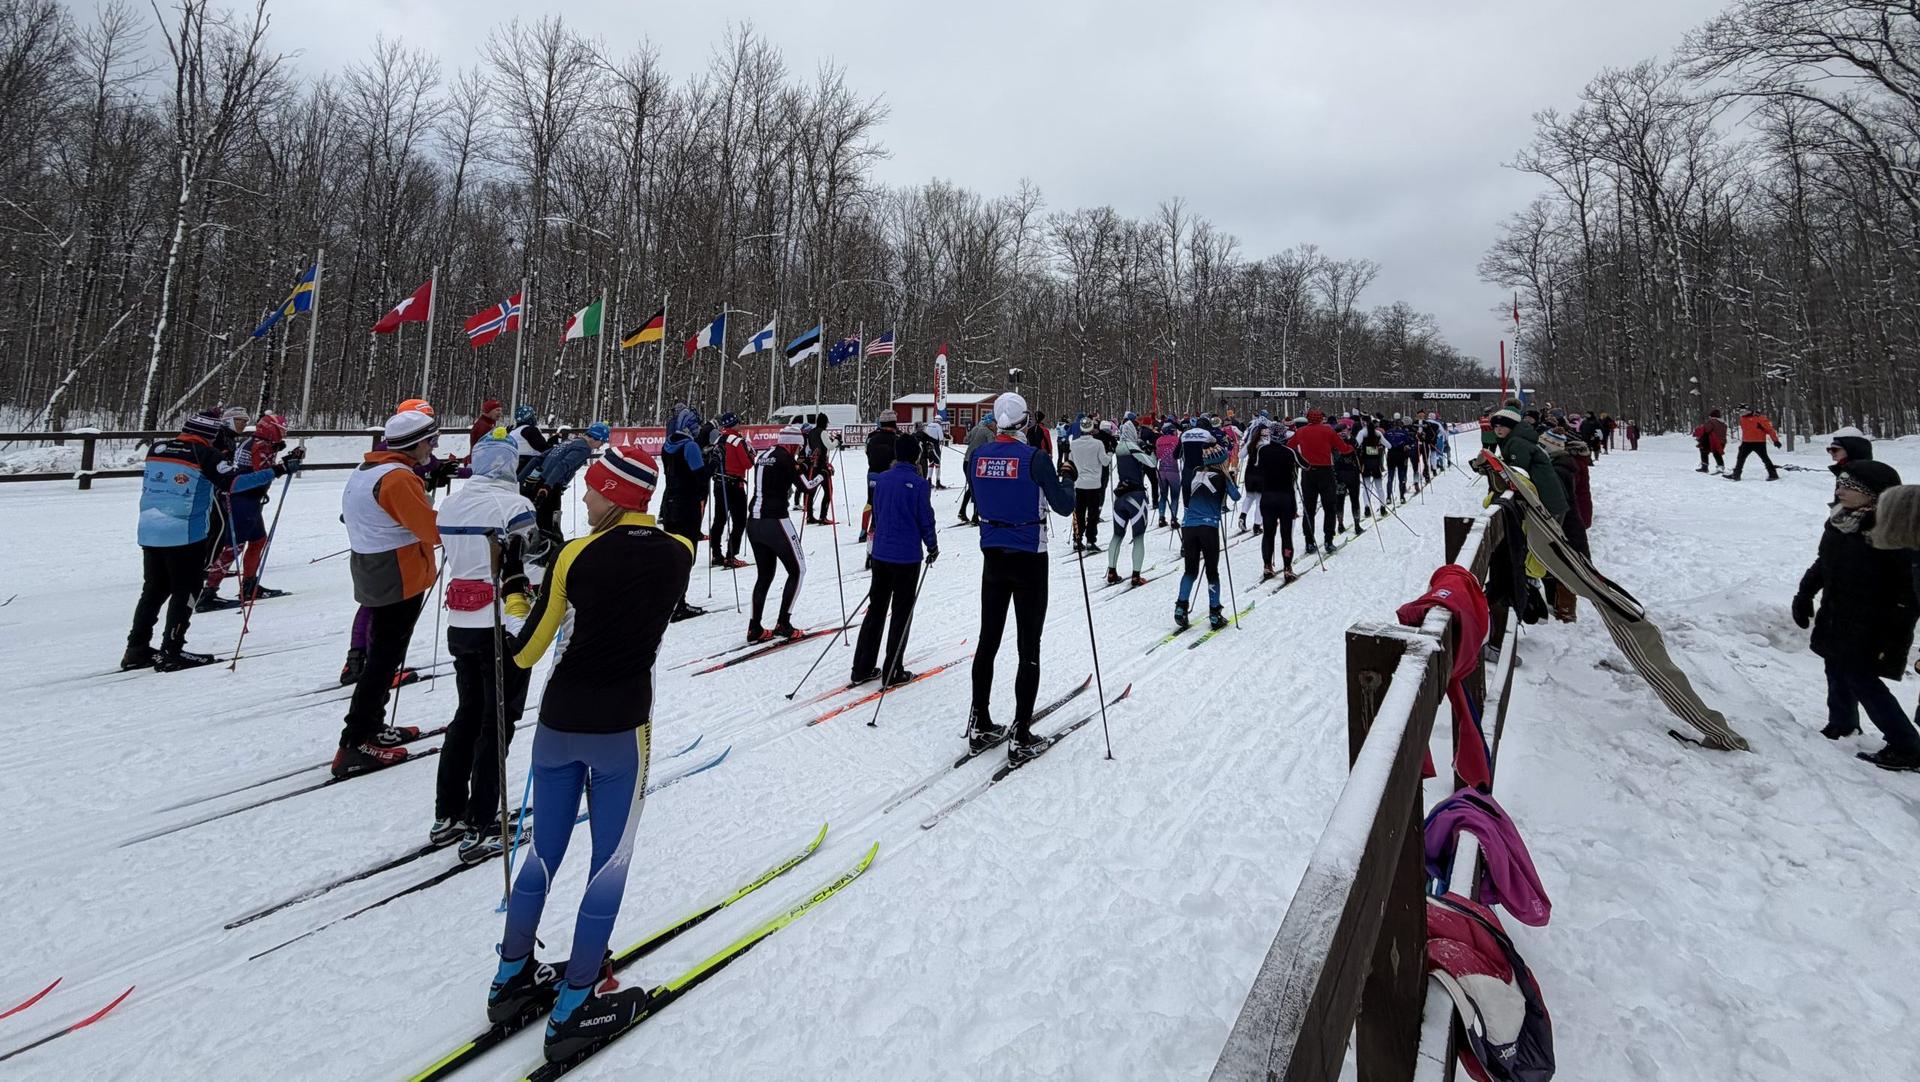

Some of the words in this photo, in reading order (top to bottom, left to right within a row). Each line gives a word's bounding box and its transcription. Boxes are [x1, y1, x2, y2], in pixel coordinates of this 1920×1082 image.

[845, 426, 861, 434] GEAR
[633, 437, 666, 445] ATOMI
[753, 433, 779, 441] ATOMI
